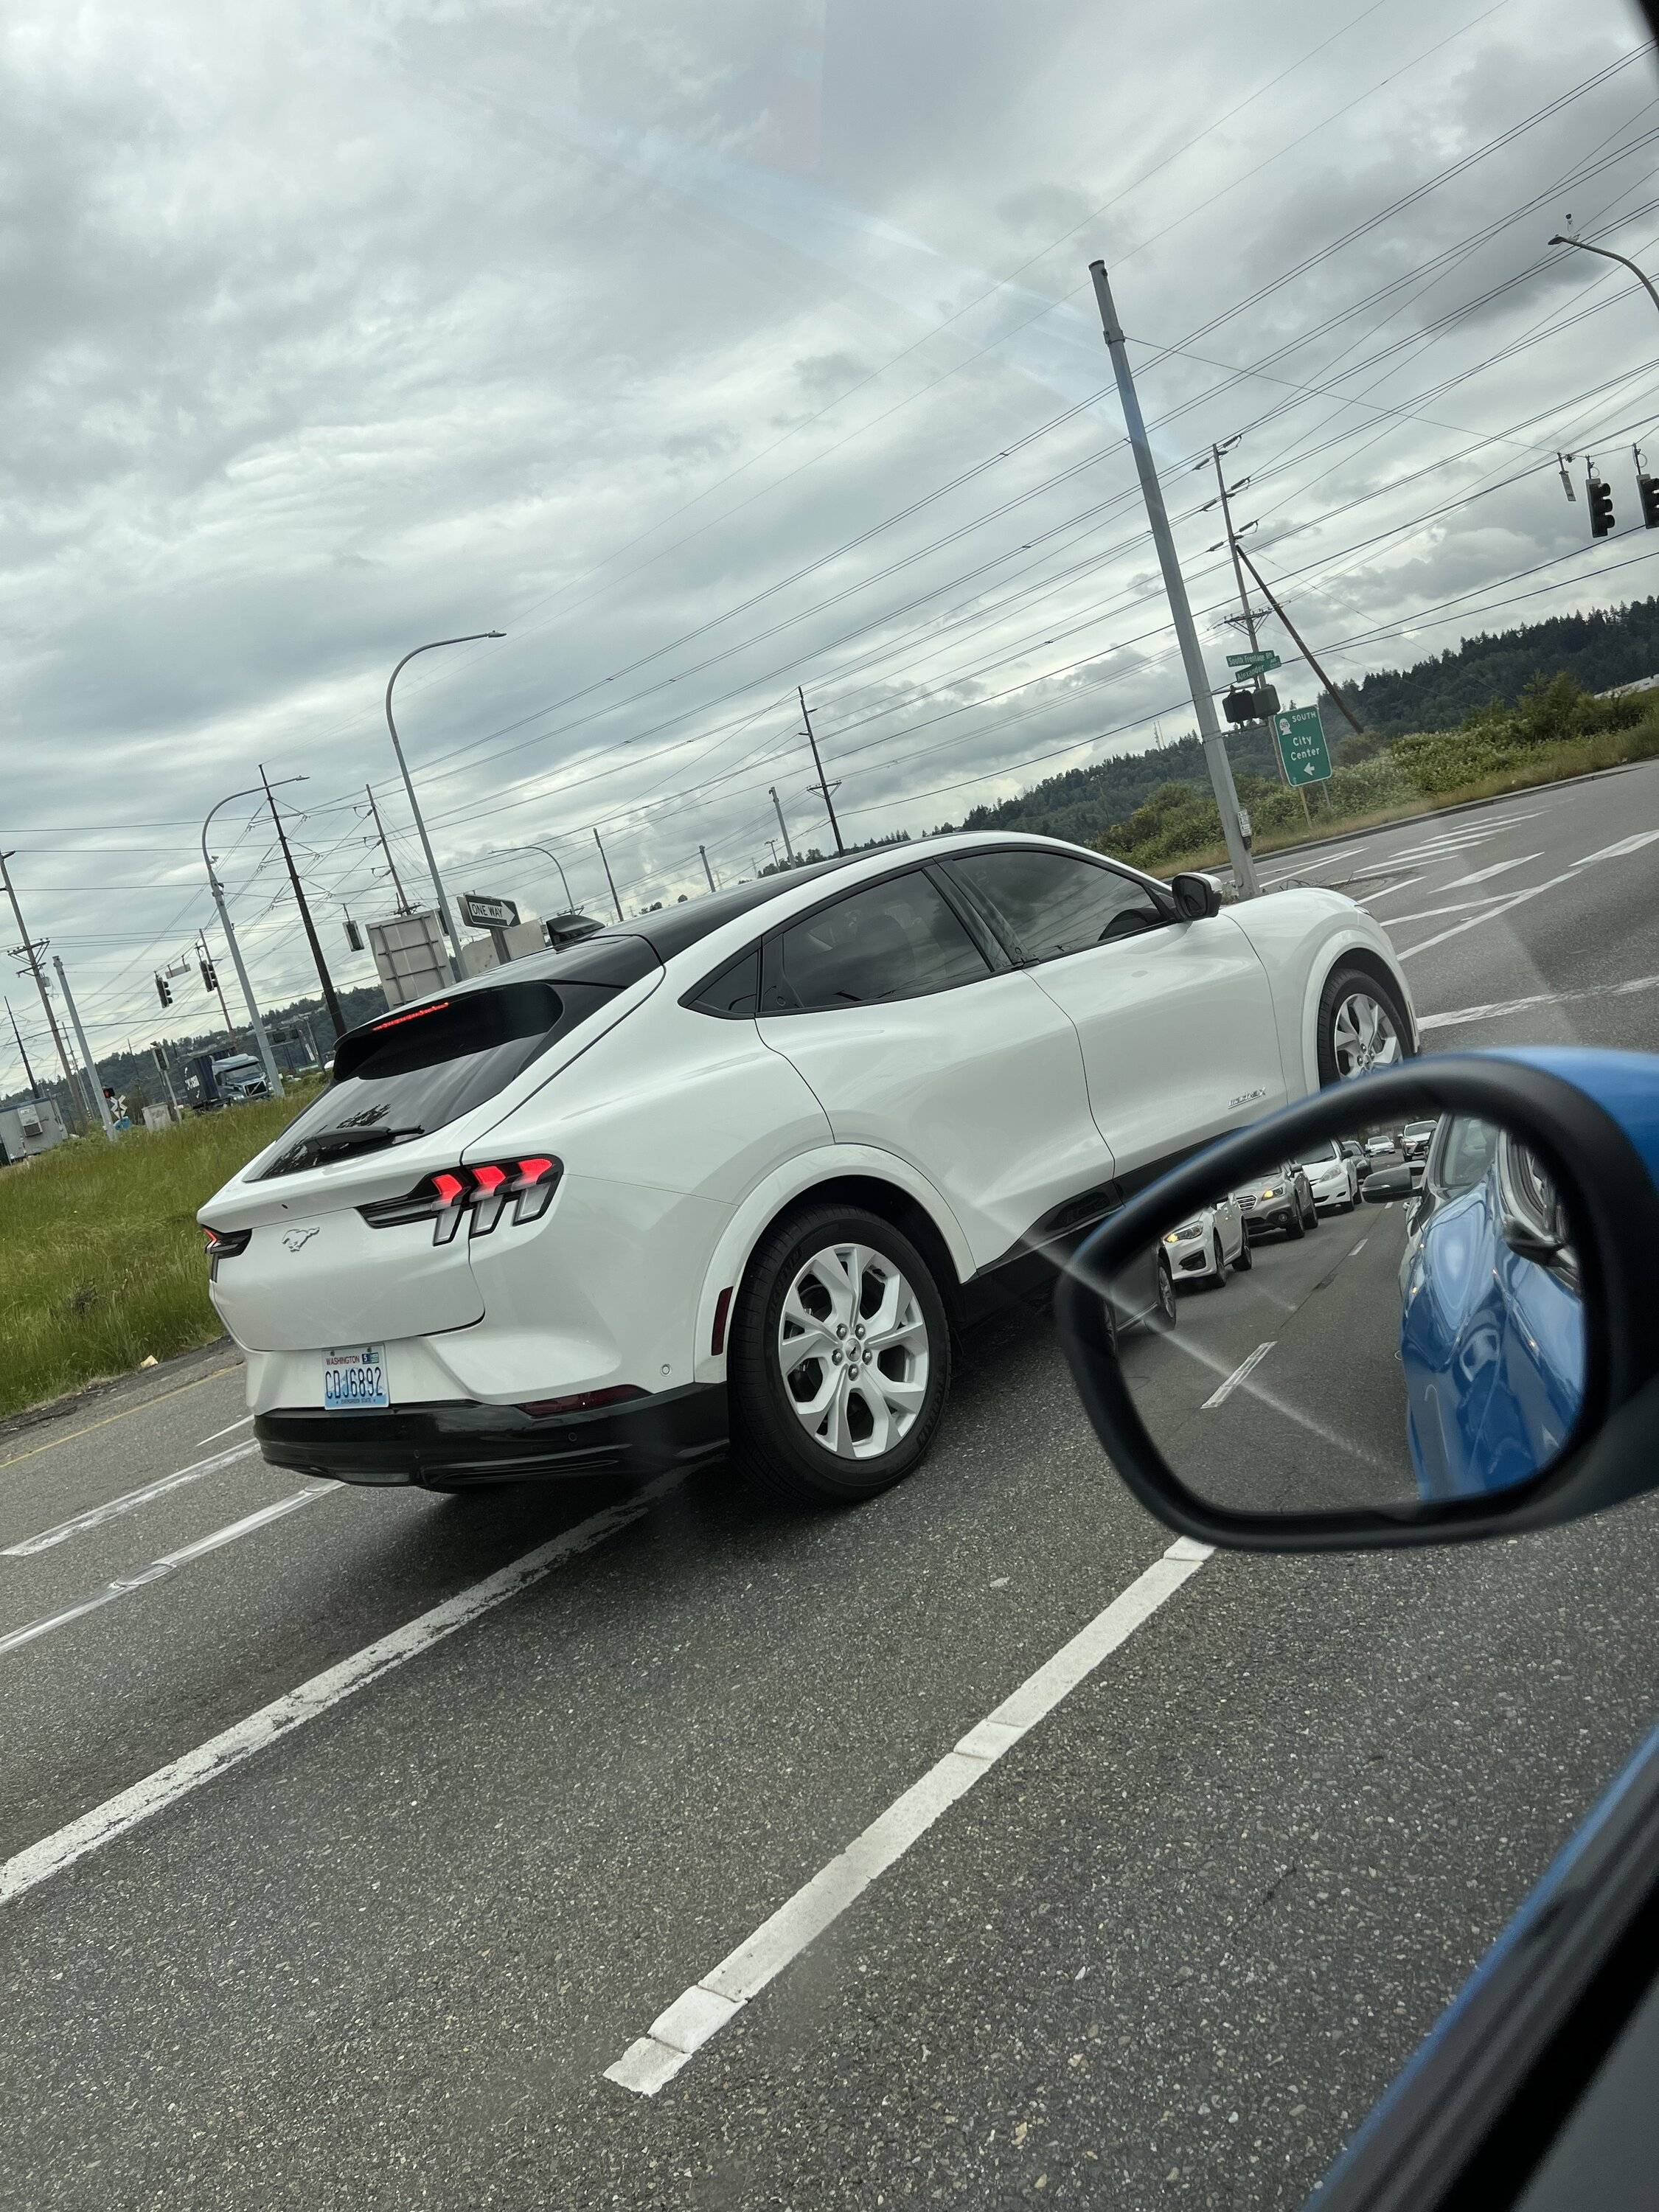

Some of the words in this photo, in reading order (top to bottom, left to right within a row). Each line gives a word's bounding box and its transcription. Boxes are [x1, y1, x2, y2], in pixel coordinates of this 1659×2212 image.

[1228, 655, 1244, 665] South
[1238, 665, 1265, 680] Alexander
[1292, 711, 1316, 723] SOUTH
[1293, 736, 1312, 746] City
[1291, 748, 1320, 761] Center
[472, 904, 487, 916] ONE
[489, 905, 502, 917] WAY
[326, 1355, 360, 1366] WASHINGTON
[325, 1366, 383, 1399] CDJ6892
